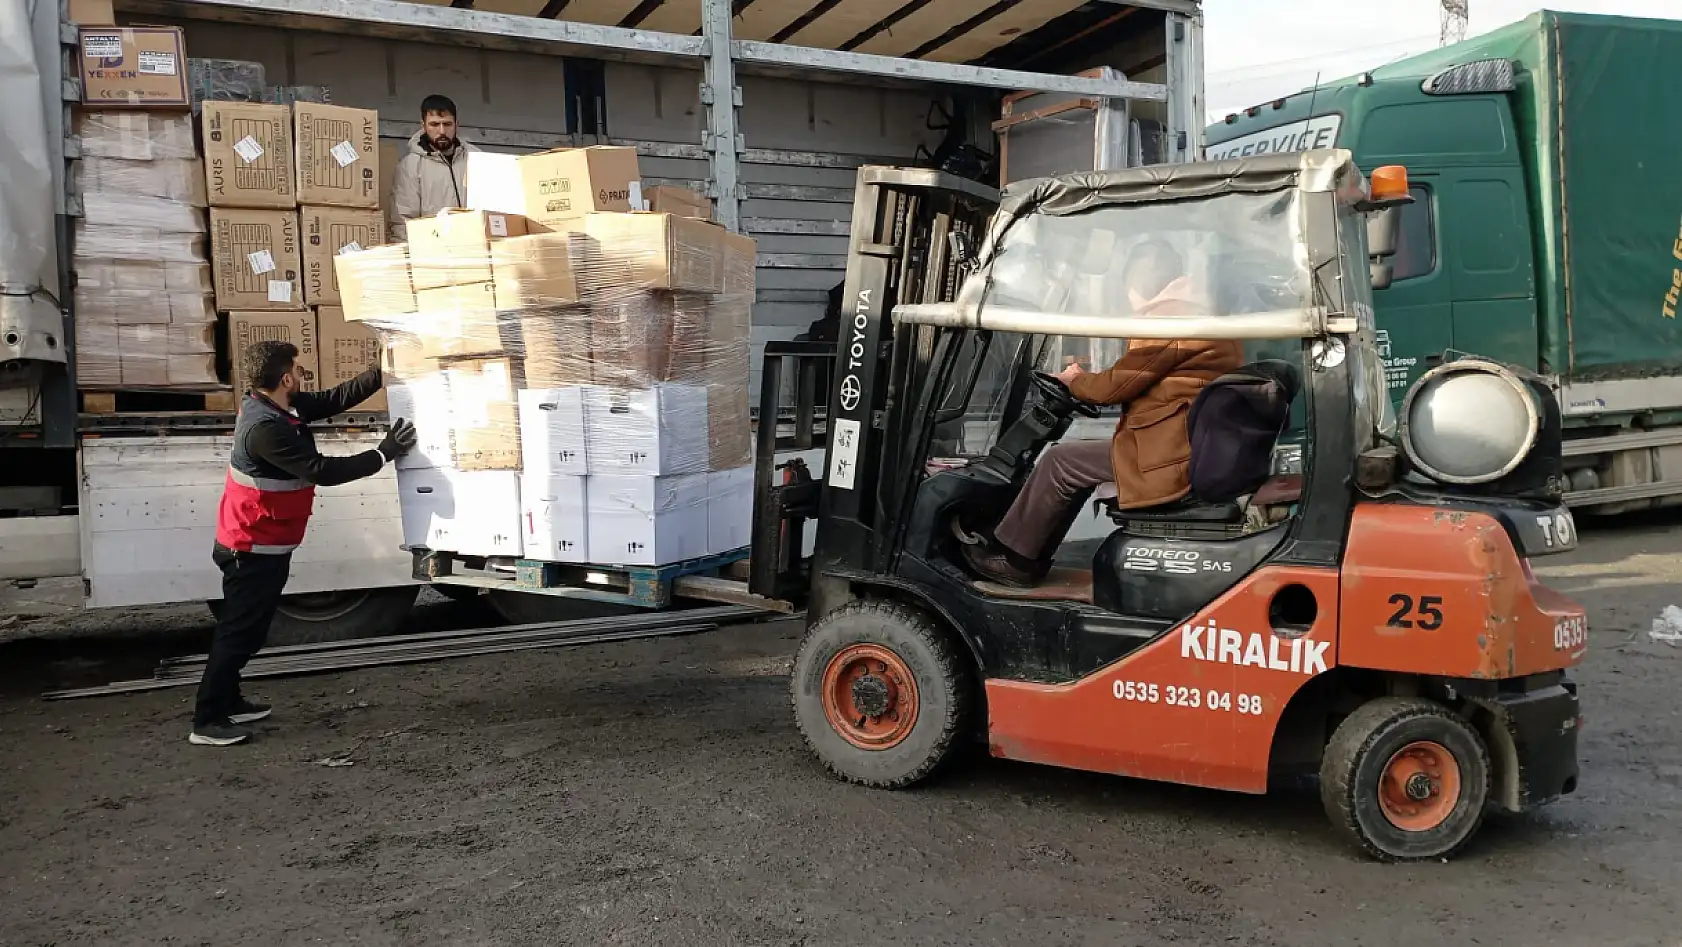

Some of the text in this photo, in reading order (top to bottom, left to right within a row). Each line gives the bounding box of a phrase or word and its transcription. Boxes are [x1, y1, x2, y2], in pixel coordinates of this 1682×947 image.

[88, 70, 137, 79] YEXXEN
[362, 116, 373, 153] AURIS
[212, 158, 225, 196] AURIS
[282, 217, 294, 254] AURIS
[310, 261, 322, 297] AURIS
[300, 318, 312, 355] AURIS
[850, 289, 872, 370] TOYOTA
[1394, 357, 1417, 367] Group
[1123, 557, 1232, 574] 25 SAS
[1383, 593, 1443, 630] 25
[1181, 619, 1331, 675] KİRALIK
[1112, 679, 1263, 716] 0535 323 04 98
